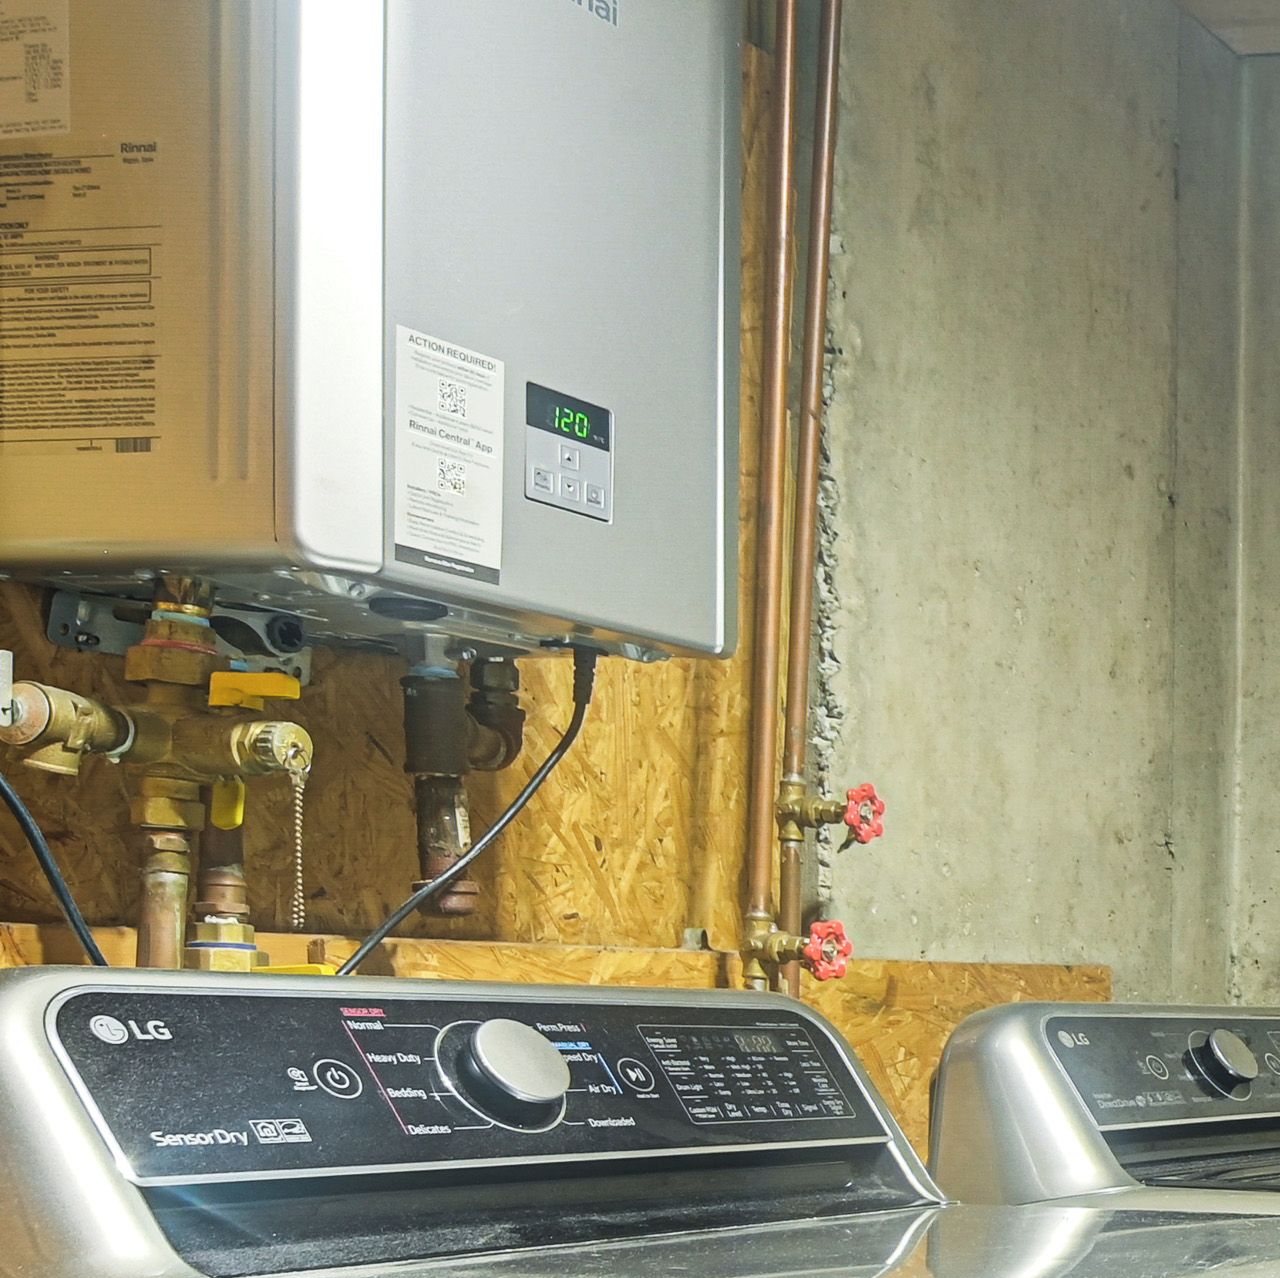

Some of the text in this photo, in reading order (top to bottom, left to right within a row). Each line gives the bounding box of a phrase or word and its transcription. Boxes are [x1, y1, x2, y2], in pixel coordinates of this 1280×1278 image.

[120, 142, 157, 153] Rinnai
[408, 334, 446, 354] ACTION
[446, 347, 497, 373] REQUIRED!
[555, 406, 590, 439] 120
[409, 419, 437, 436] Rinnai
[475, 440, 493, 454] App
[128, 1020, 173, 1040] LG
[346, 1020, 385, 1030] Normal
[1071, 1032, 1091, 1046] LG
[366, 1052, 422, 1065] Heavy Duty
[582, 1052, 599, 1064] Dry
[386, 1087, 428, 1100] Bedding
[588, 1084, 617, 1095] Air Dry
[587, 1117, 637, 1128] Downloaded
[407, 1124, 452, 1135] Delicates
[150, 1129, 249, 1147] SensorDry
